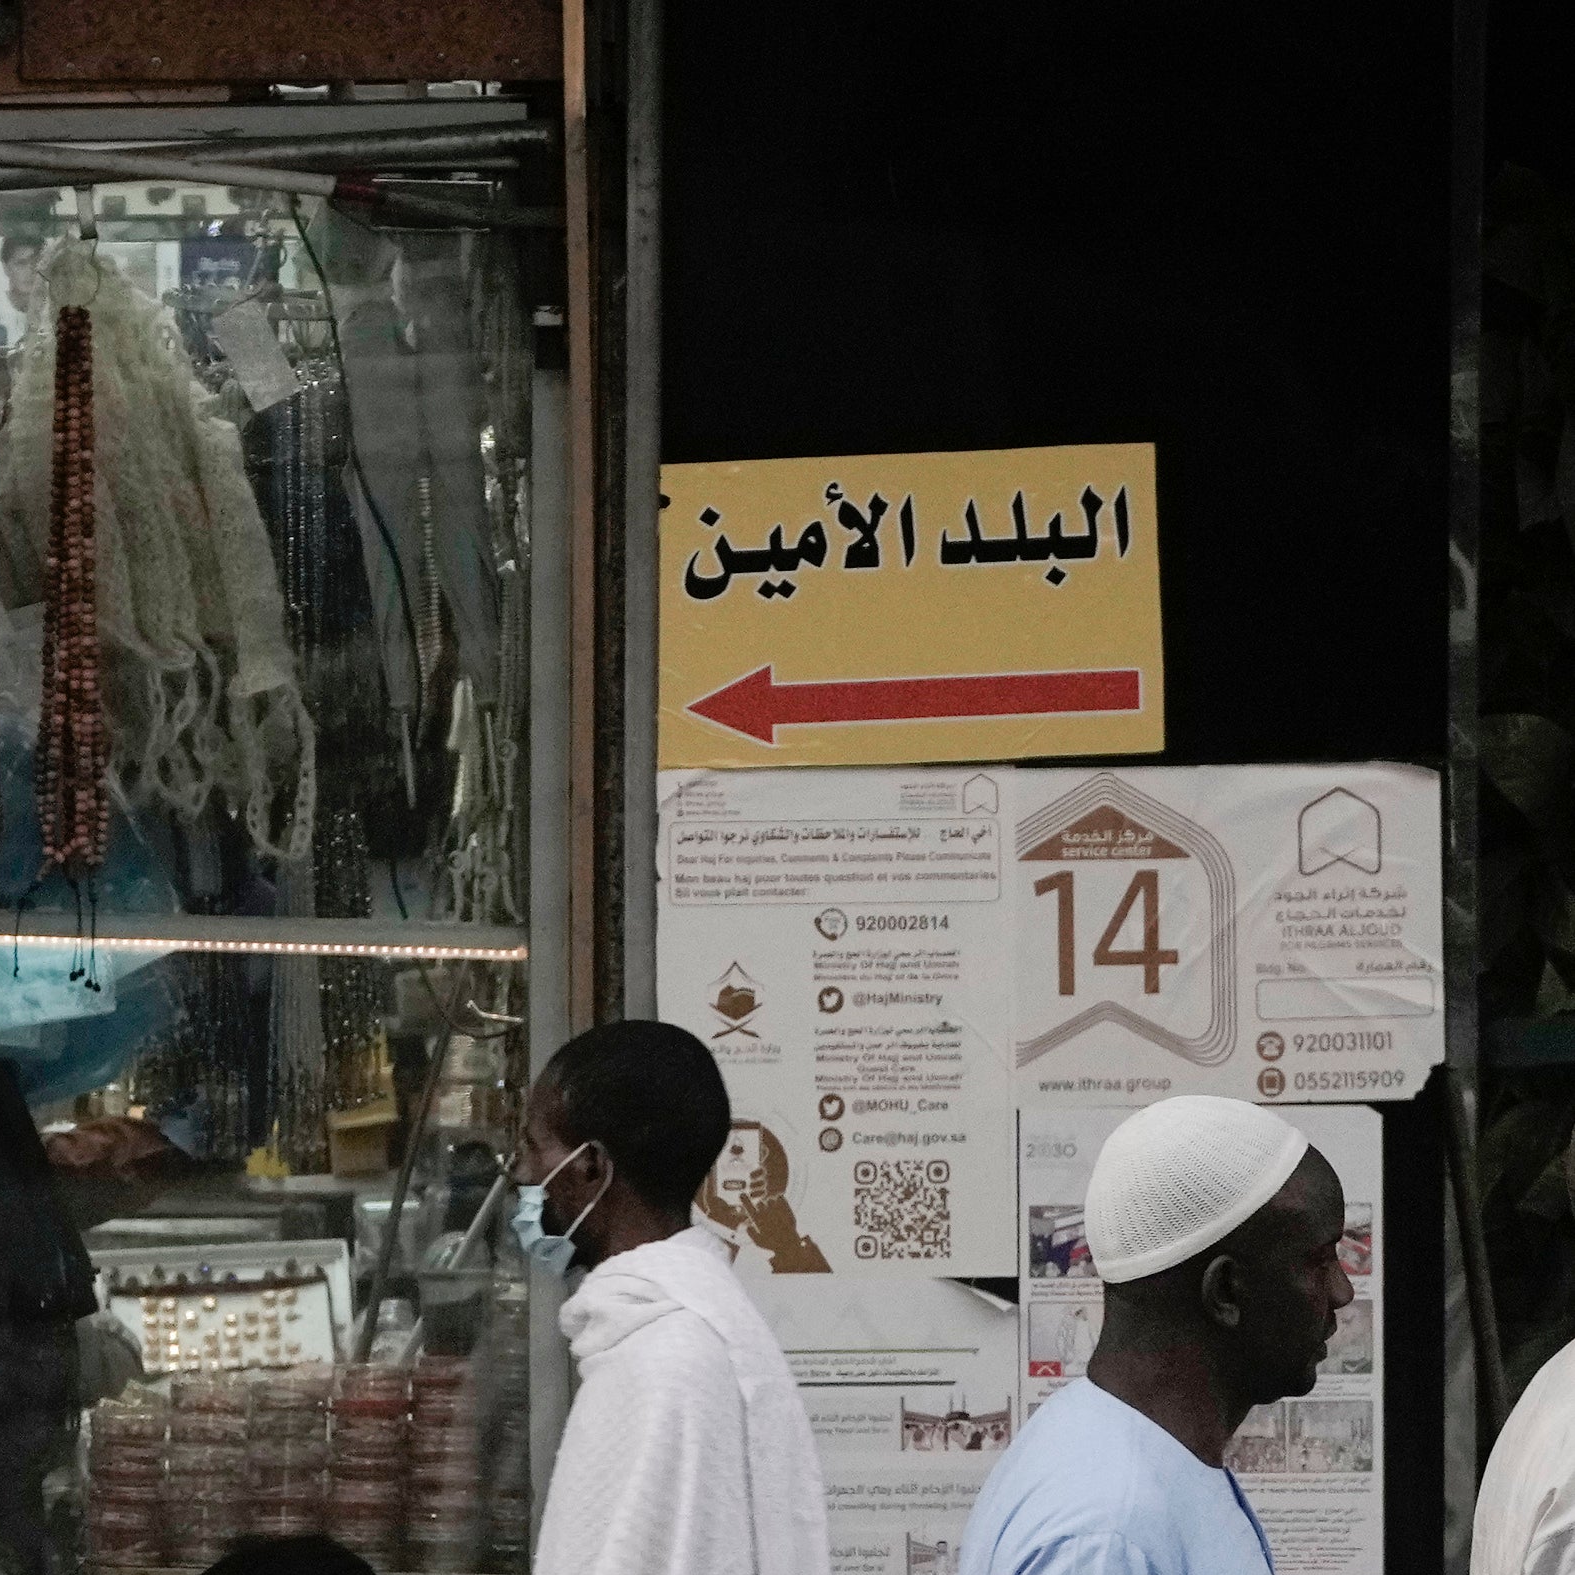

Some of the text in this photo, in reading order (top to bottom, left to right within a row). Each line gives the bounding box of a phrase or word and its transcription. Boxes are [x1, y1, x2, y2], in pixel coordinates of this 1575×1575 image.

[683, 482, 1131, 600] البلد الأمين
[1060, 829, 1112, 844] الخدمة
[1062, 845, 1152, 859] service center
[1357, 884, 1408, 902] شركة
[855, 913, 950, 931] 920002814
[1281, 922, 1403, 938] ITHRAA ALJOUD
[1034, 869, 1179, 995] 14
[852, 991, 944, 1008] @HajMinistry
[1293, 1031, 1393, 1053] 920031101
[1038, 1077, 1172, 1093] www.ithraa.group
[1294, 1069, 1405, 1090] 0552115909
[852, 1098, 949, 1115] @MOHU_Care
[852, 1132, 967, 1147] Care@haj.gov.sa
